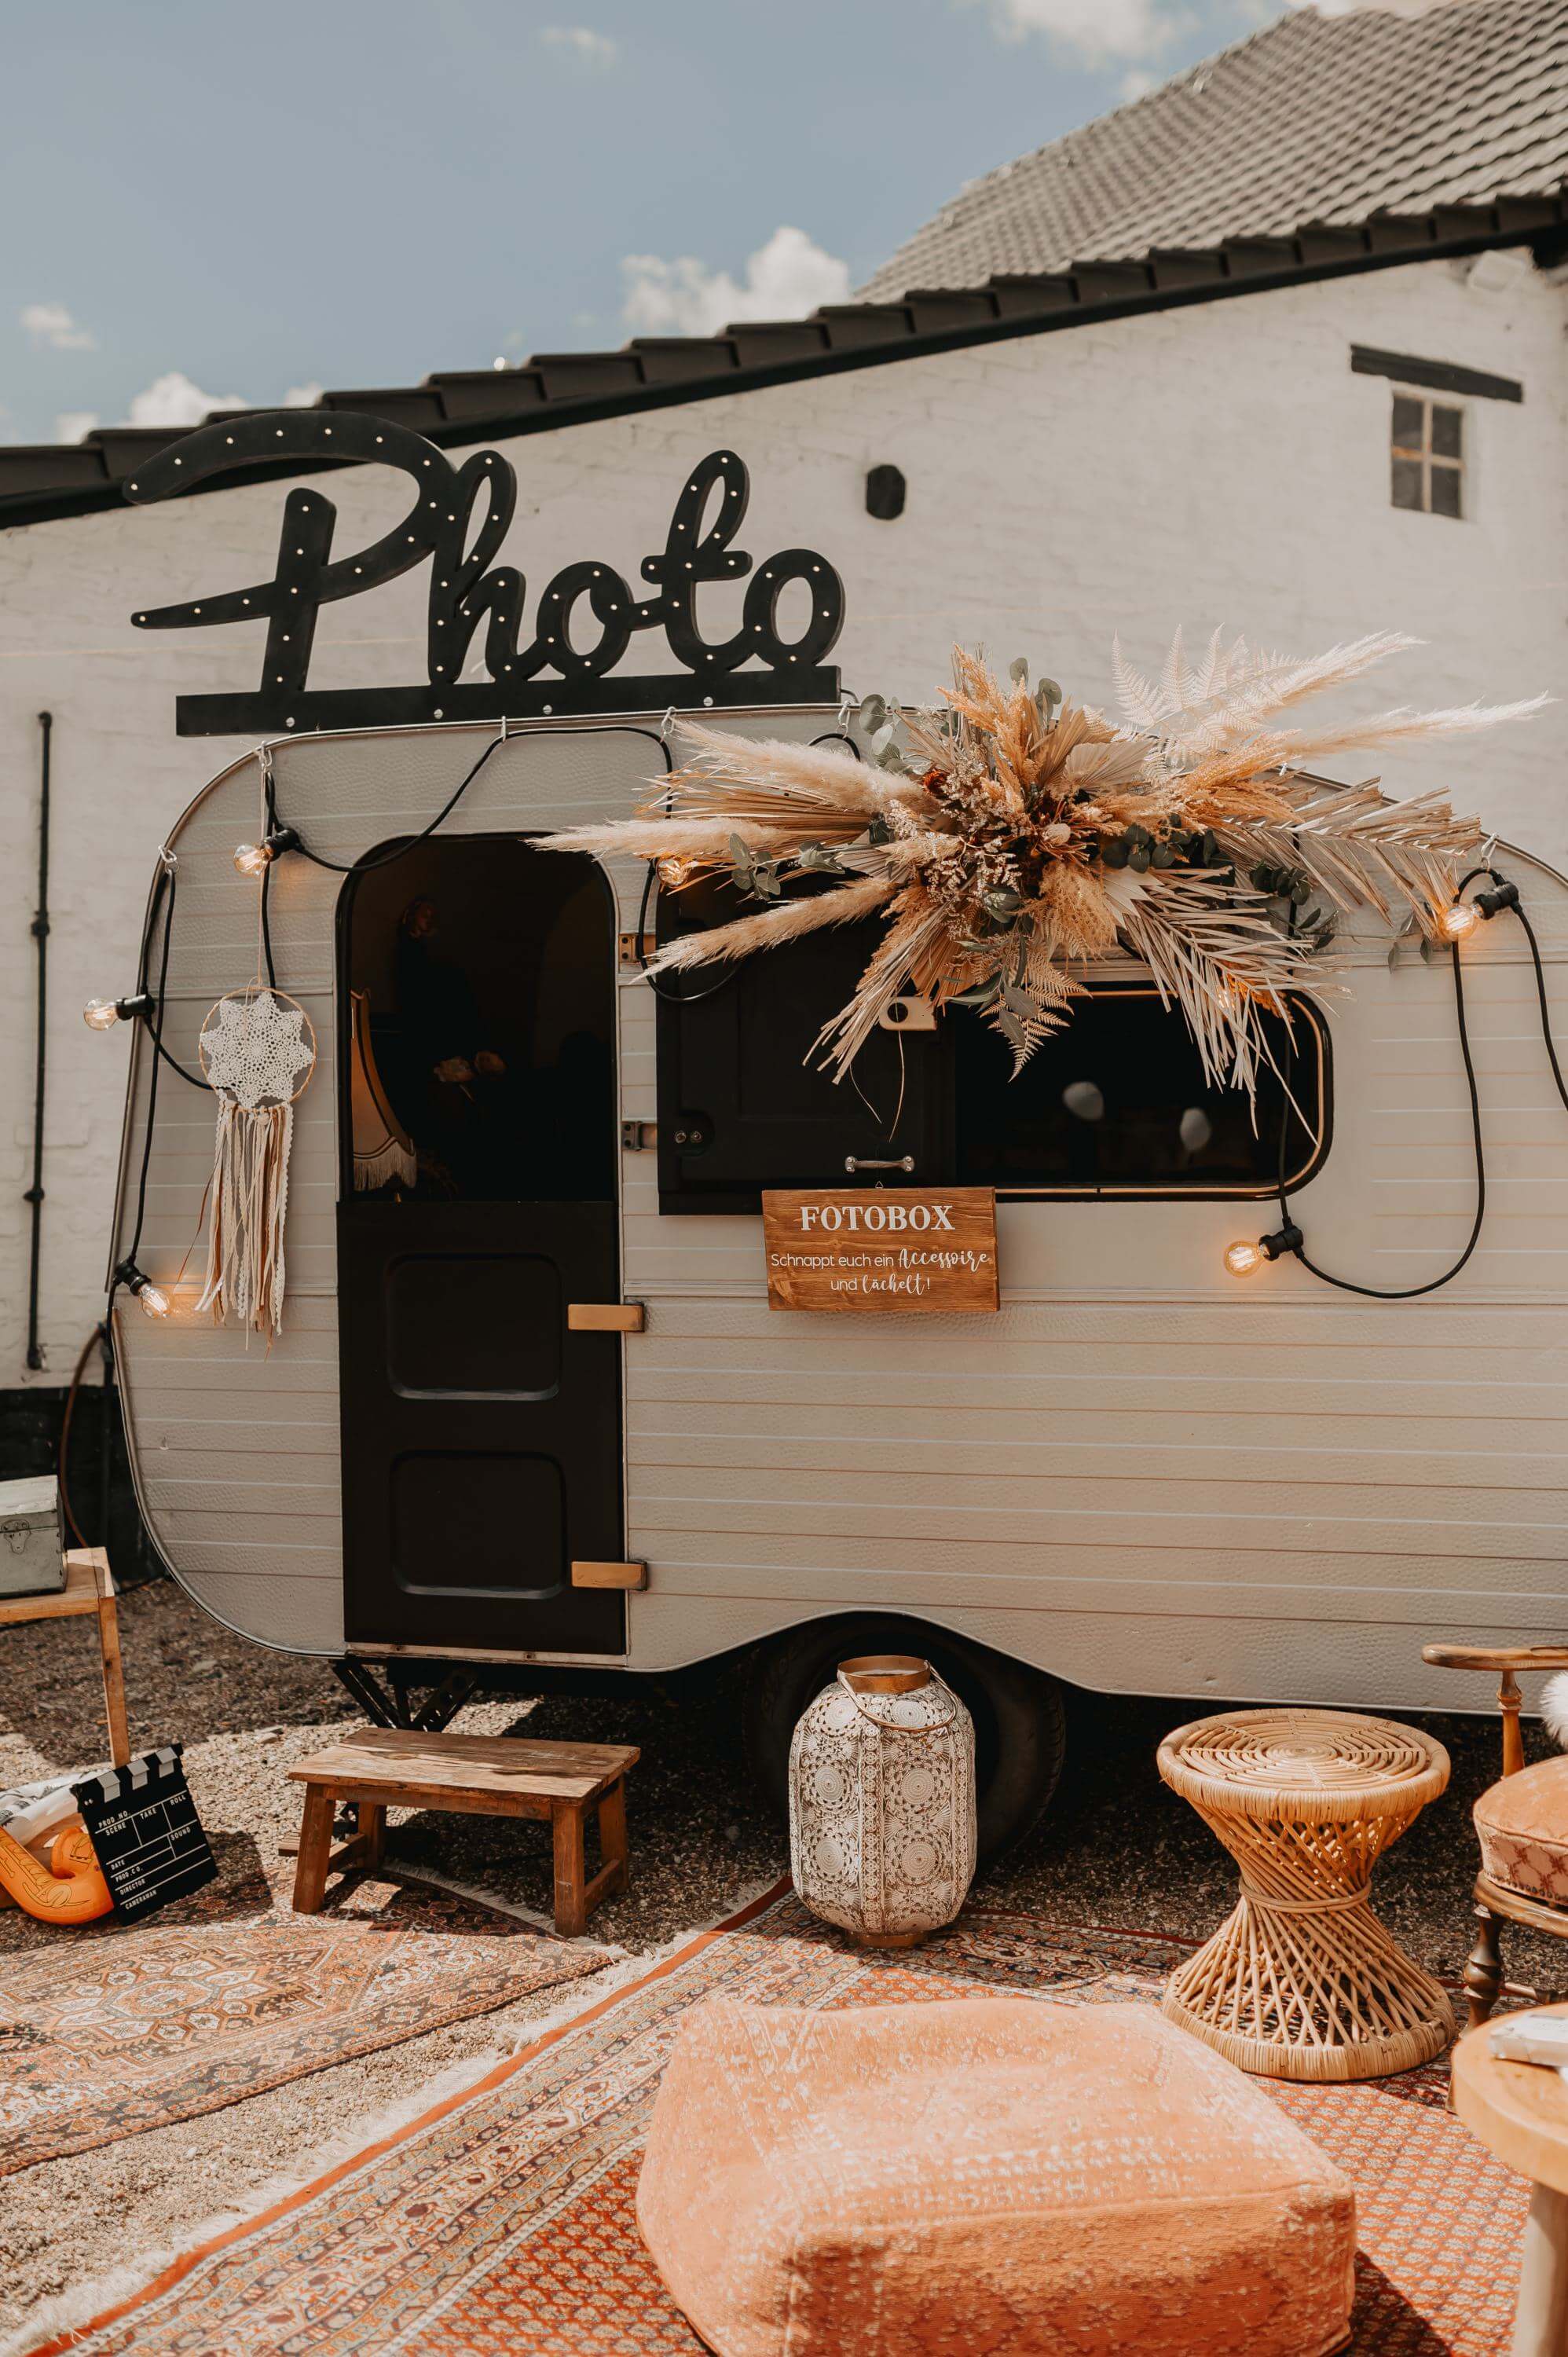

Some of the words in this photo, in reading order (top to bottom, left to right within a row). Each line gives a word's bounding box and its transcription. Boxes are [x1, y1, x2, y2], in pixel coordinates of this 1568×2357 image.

[122, 411, 844, 692] Photo
[800, 1205, 955, 1231] FOTOBOX
[771, 1254, 835, 1270] Schnappt
[838, 1253, 871, 1267] euch
[874, 1253, 894, 1267] ein
[897, 1248, 990, 1272] Accessoire
[830, 1277, 858, 1291] und
[170, 1794, 186, 1805] ROLL
[140, 1807, 157, 1820] TAKE
[105, 1821, 126, 1836] SCENE
[170, 1827, 191, 1841] SOUND
[111, 1859, 126, 1870] DATE
[119, 1879, 146, 1895] DIRECTOR
[125, 1890, 157, 1910] CAMERAMAN
